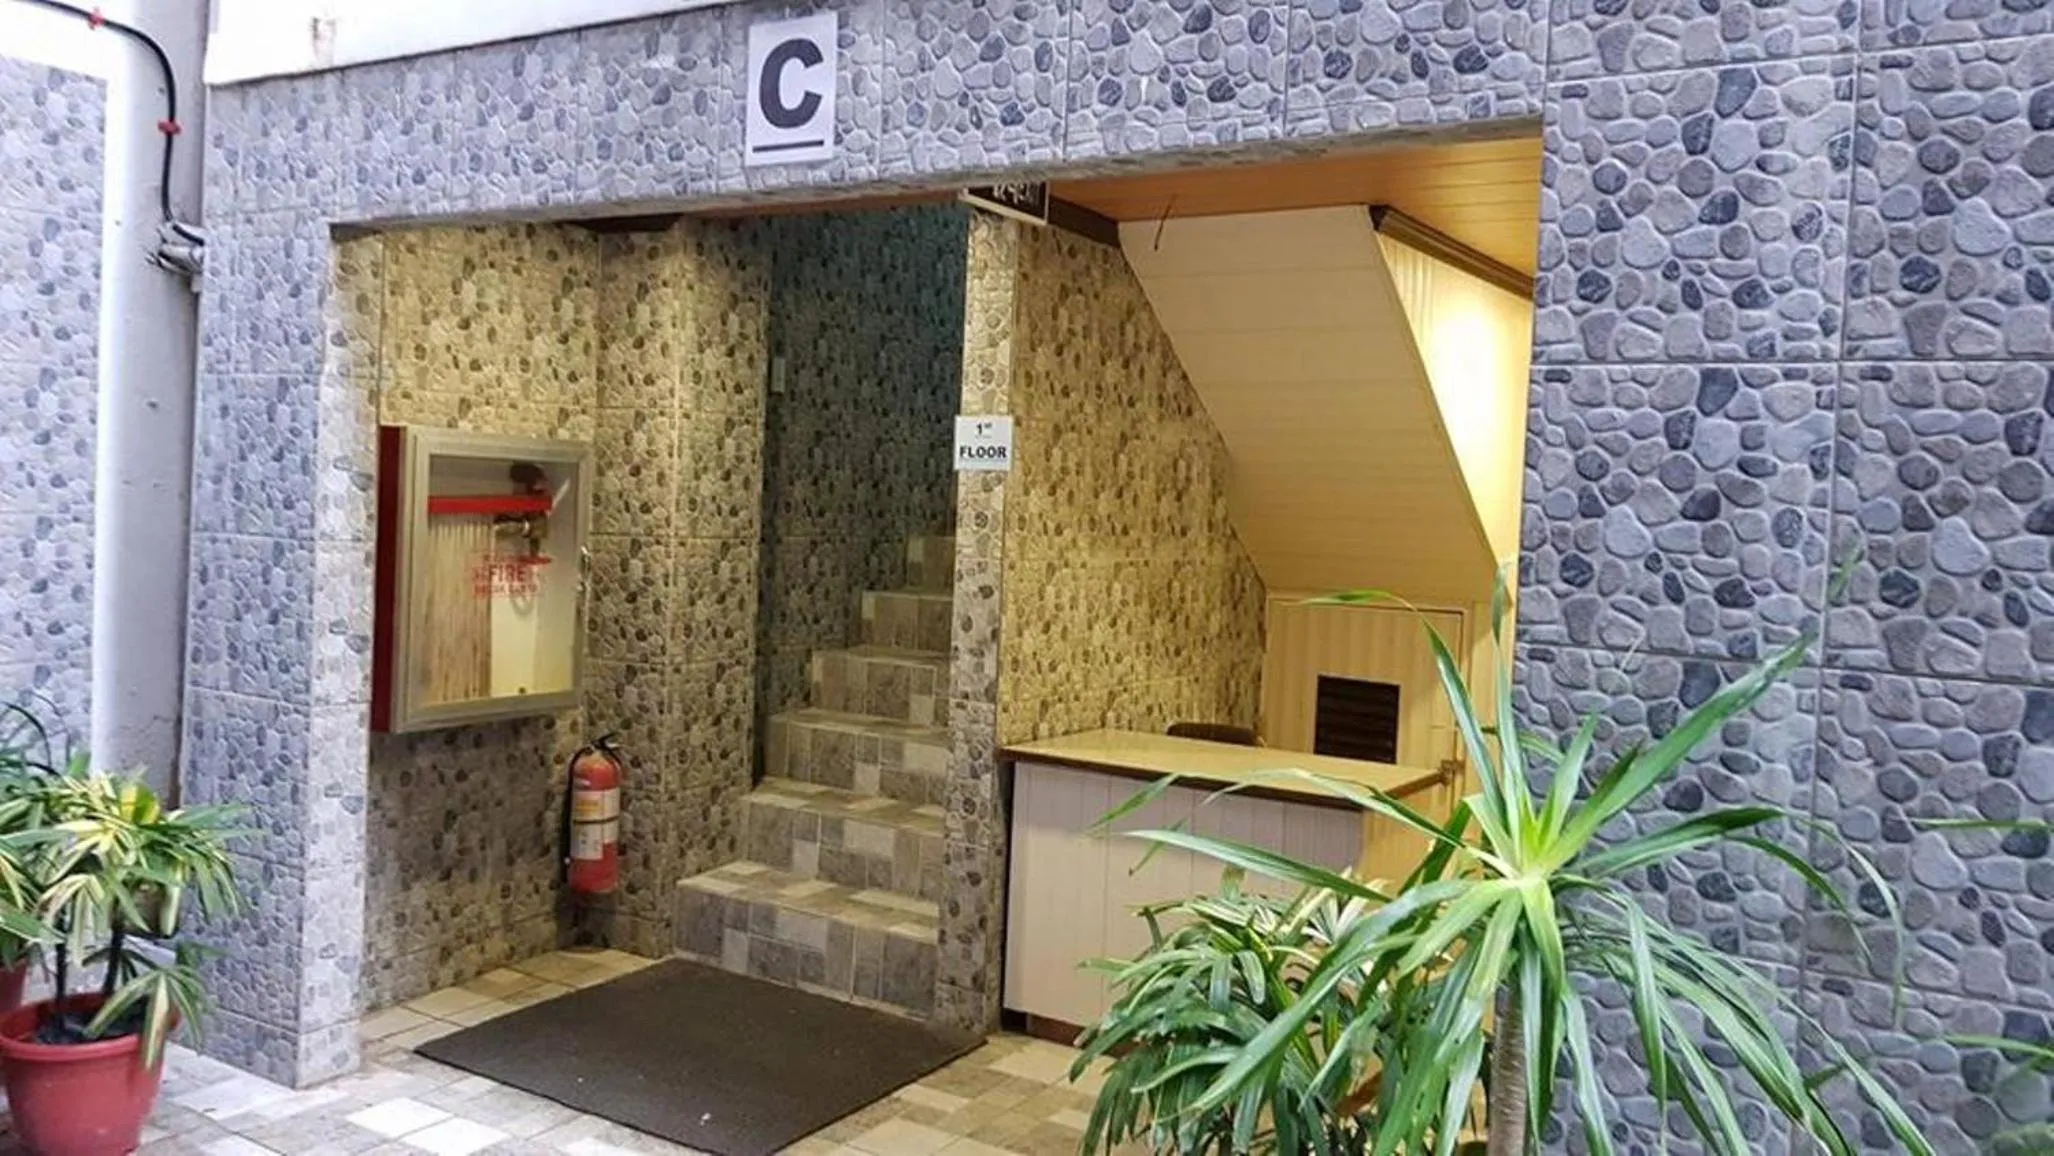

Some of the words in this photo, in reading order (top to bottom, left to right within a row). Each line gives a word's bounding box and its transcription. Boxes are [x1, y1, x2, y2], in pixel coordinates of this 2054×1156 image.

[759, 38, 824, 129] C
[960, 445, 1007, 459] FLOOR
[488, 564, 525, 582] FIRE
